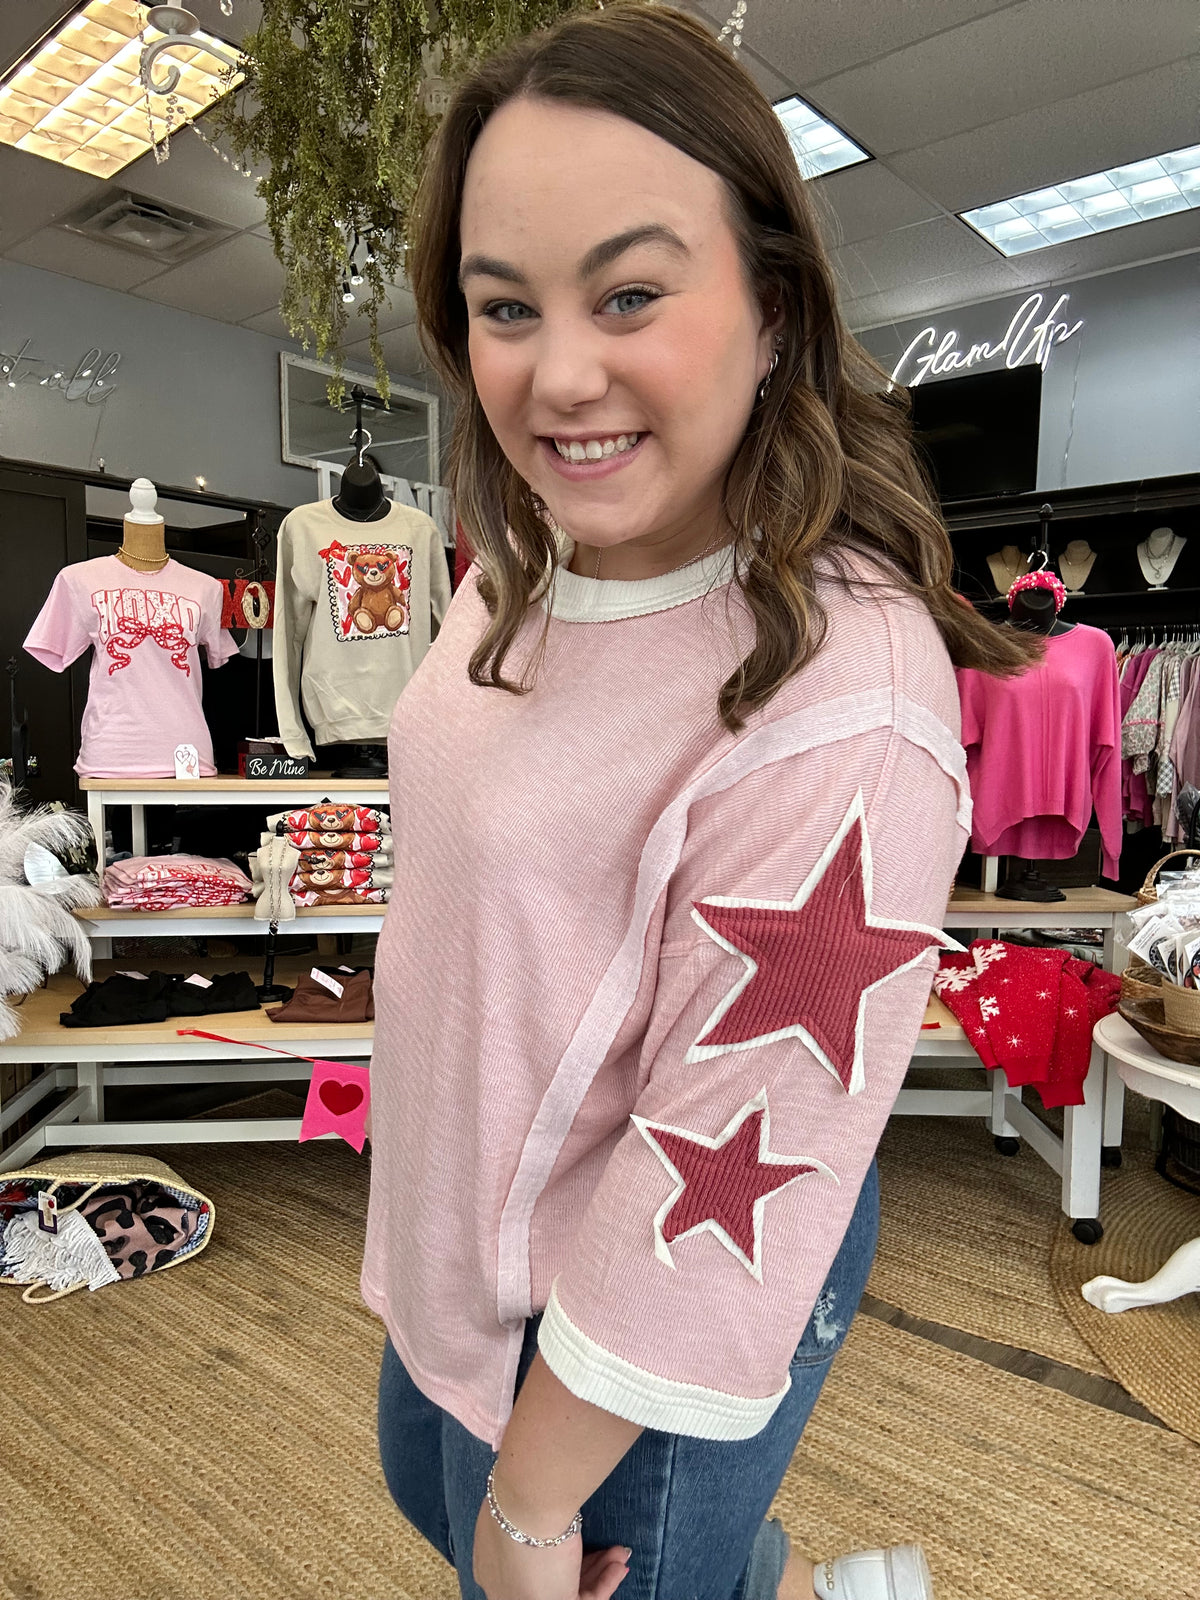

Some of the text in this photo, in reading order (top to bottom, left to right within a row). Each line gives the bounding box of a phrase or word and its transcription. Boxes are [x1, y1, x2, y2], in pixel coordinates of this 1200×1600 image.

[886, 327, 1005, 393] Glam
[91, 588, 201, 645] XOXO
[249, 758, 306, 777] Be Mine
